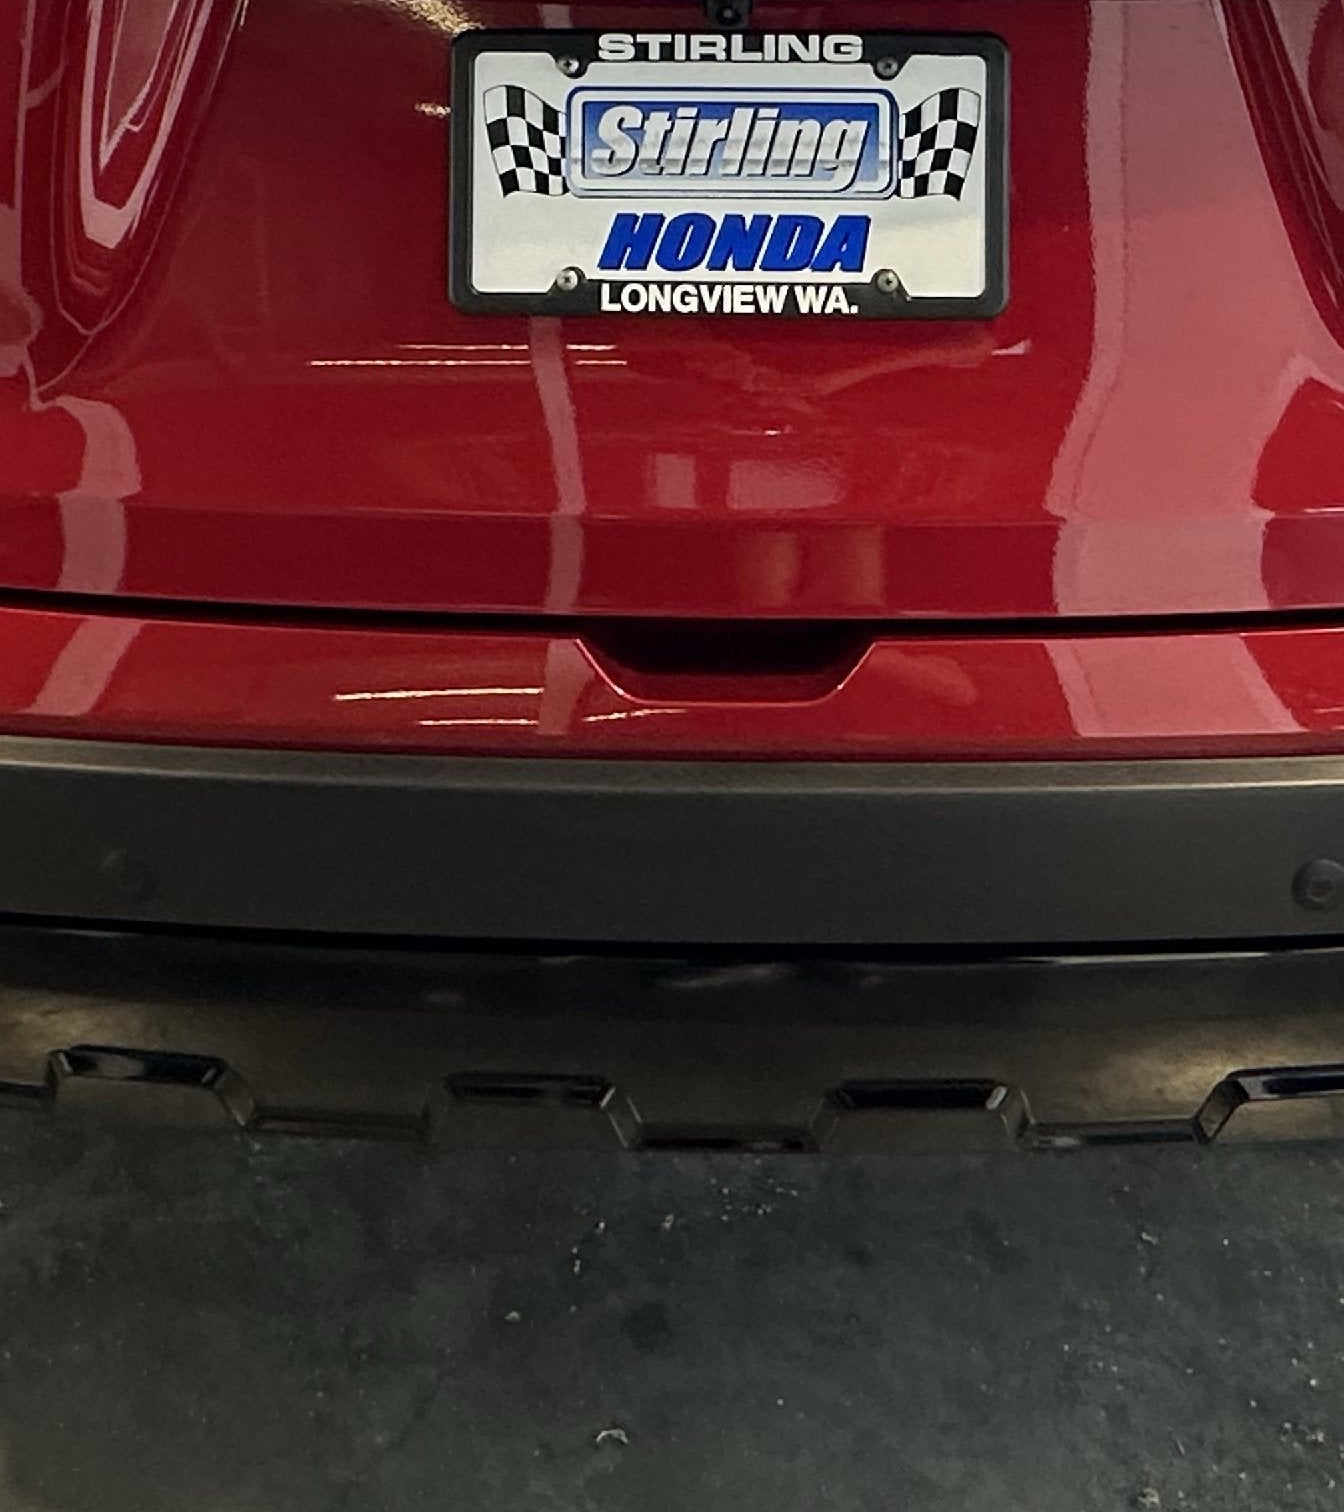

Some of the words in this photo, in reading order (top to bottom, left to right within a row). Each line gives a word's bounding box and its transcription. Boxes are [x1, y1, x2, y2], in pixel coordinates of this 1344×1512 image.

[598, 34, 863, 62] STIRLING
[592, 104, 869, 185] Stirling
[598, 212, 871, 272] HONDA
[600, 285, 790, 314] LONGVIEW
[794, 285, 859, 315] WA.
